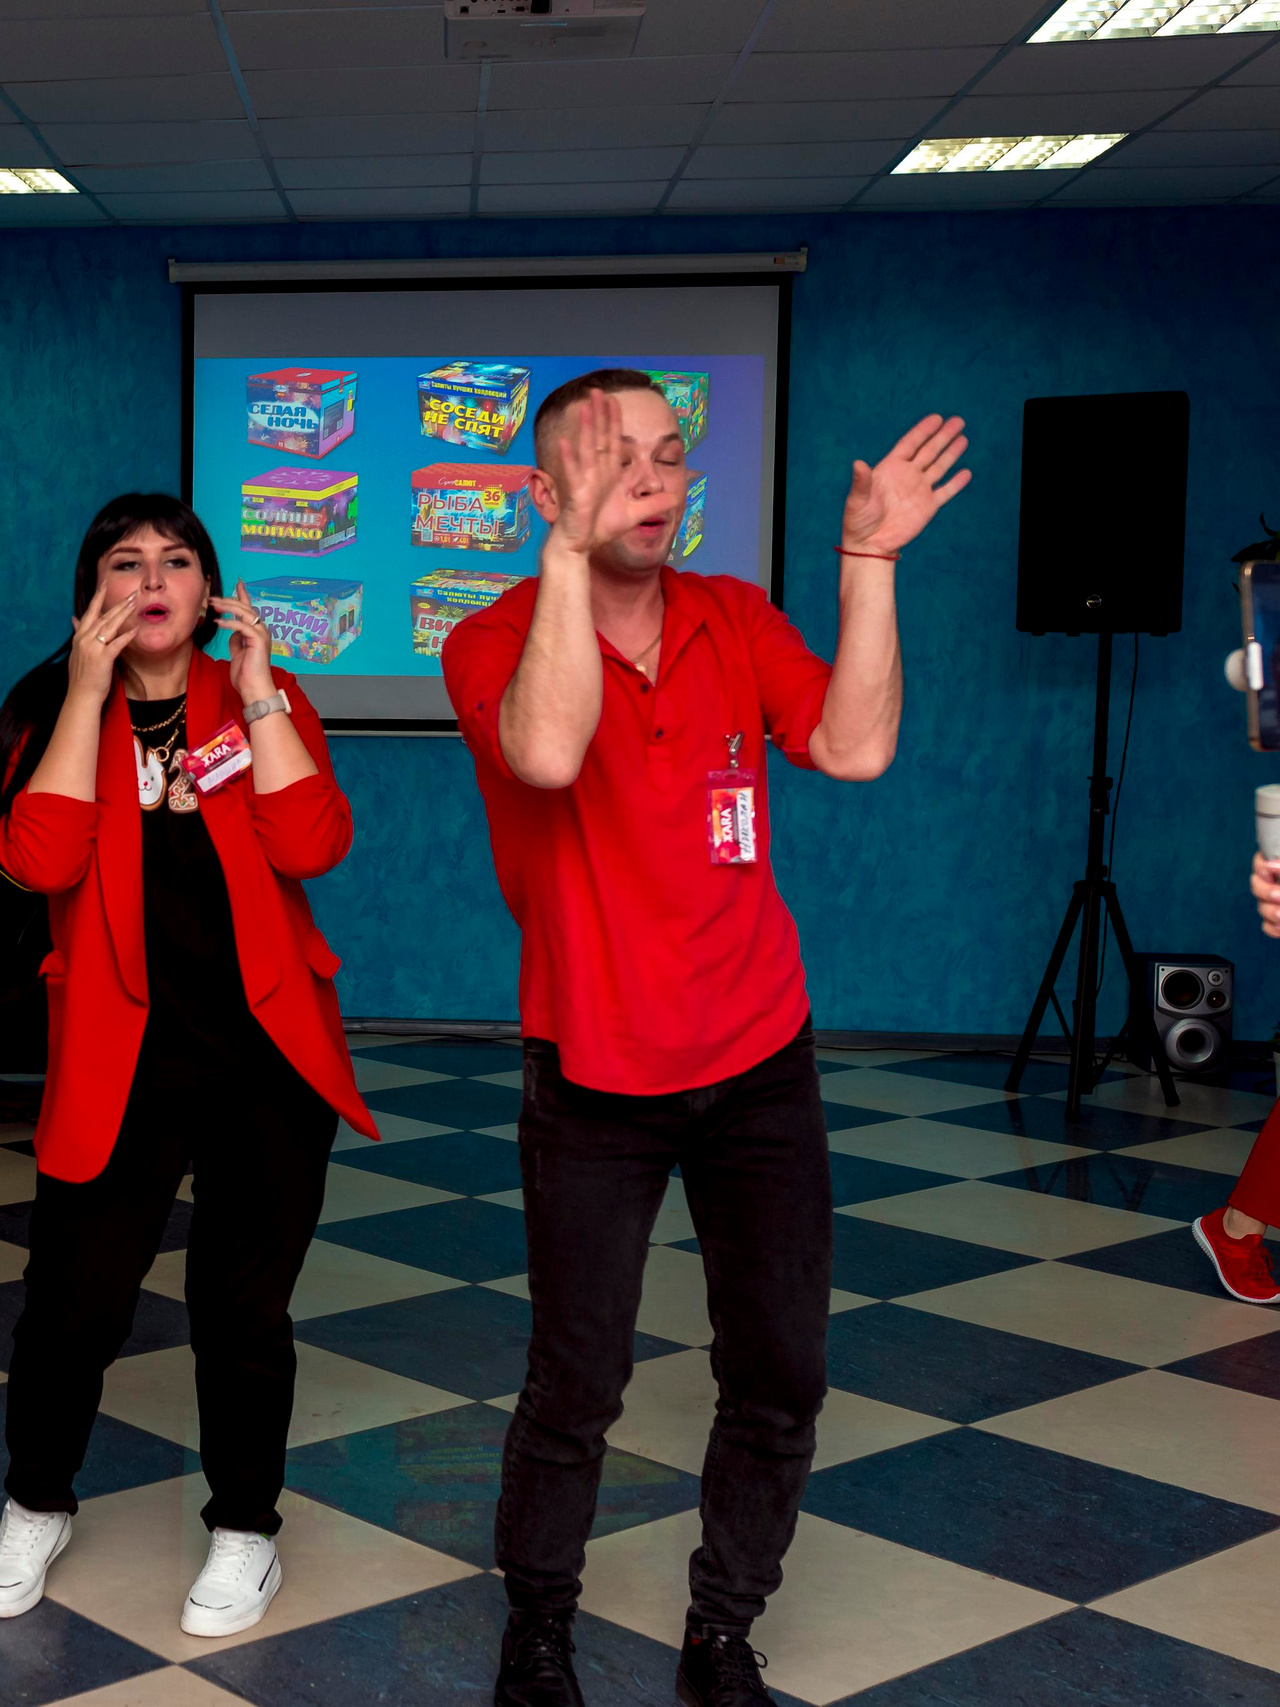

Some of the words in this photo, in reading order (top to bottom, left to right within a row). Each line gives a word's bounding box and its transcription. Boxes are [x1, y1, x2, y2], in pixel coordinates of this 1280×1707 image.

[247, 402, 307, 418] СЕДАЯ
[429, 399, 506, 425] СОСЕДИ
[267, 416, 318, 430] НОЧЬ
[424, 410, 449, 425] НЕ
[454, 418, 504, 438] СПЯТ
[417, 493, 484, 513] РЫБА
[483, 490, 501, 502] 36
[242, 508, 323, 526] СОЛНЦЕ
[415, 513, 499, 536] МЕЧТЫ
[241, 523, 323, 540] МОНАКО
[267, 623, 304, 645] КУС
